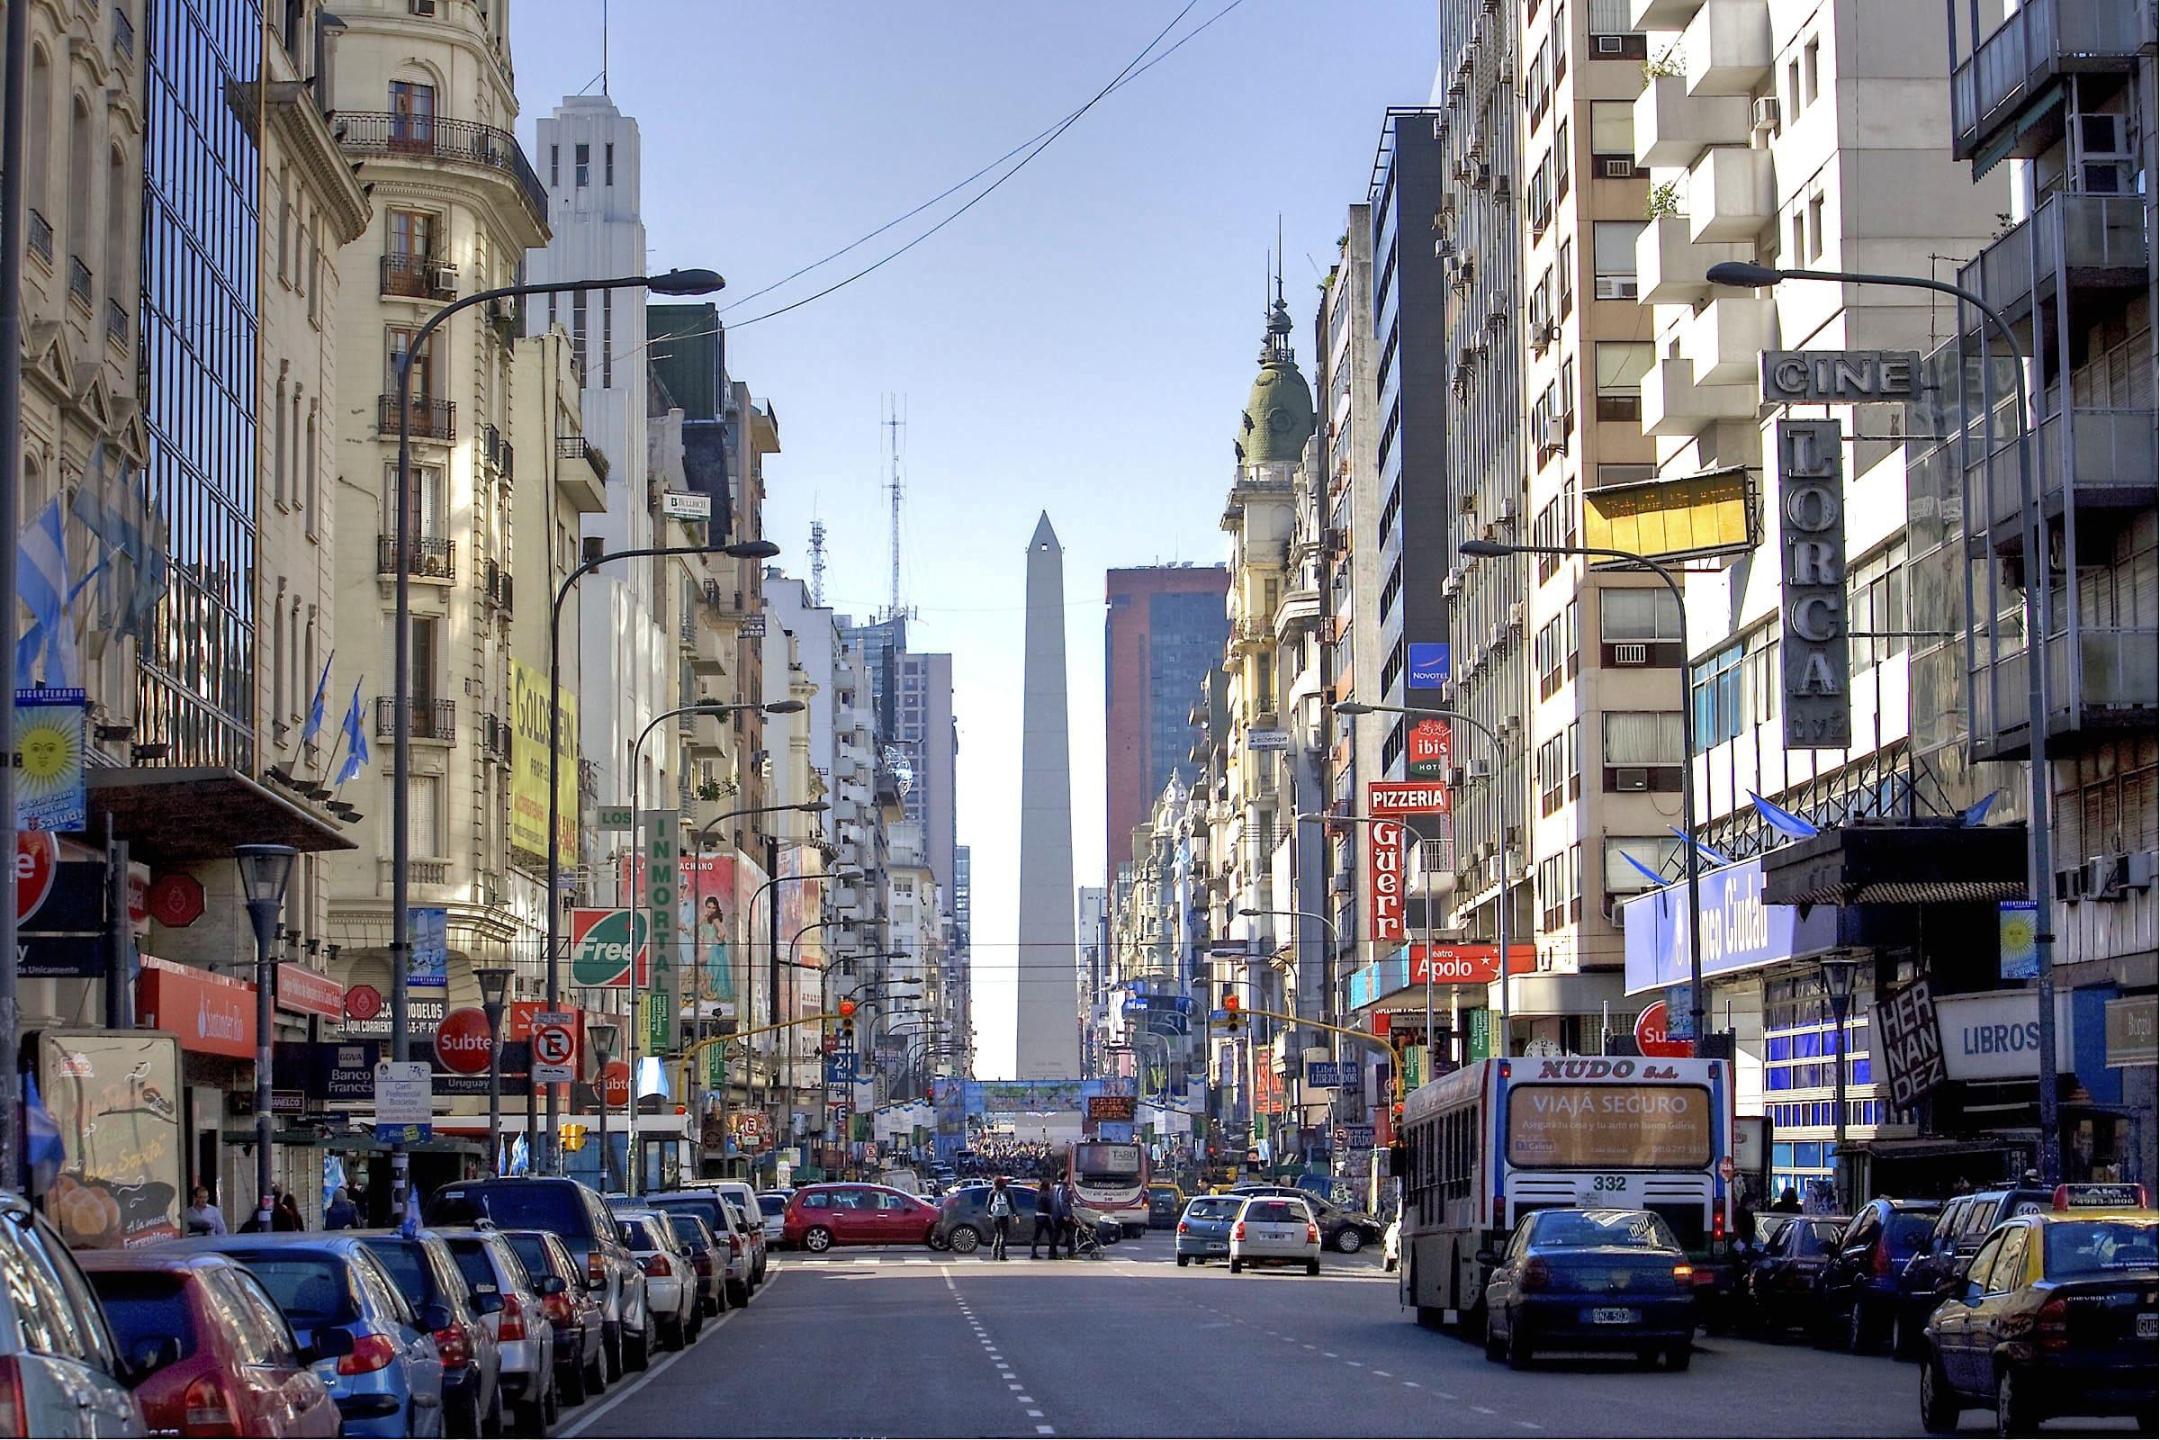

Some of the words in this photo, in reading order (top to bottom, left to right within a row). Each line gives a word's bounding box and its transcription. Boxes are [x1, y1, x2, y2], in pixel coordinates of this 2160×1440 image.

[1774, 358, 1912, 394] CINE
[1786, 429, 1842, 697] LORCA
[1413, 672, 1449, 680] NOVOTEL
[516, 667, 574, 760] GOLDSEIN
[1418, 739, 1447, 755] ibis
[1372, 789, 1444, 808] PIZZERIA
[602, 812, 632, 824] LOS
[652, 819, 672, 993] INMORTAL
[1725, 873, 1768, 954] Ciudad
[1417, 957, 1472, 981] Apolo
[1880, 983, 1933, 1046] HER
[442, 1034, 493, 1051] Subte
[1963, 1021, 2040, 1055] LIBROS
[339, 1052, 363, 1062] BBVA
[1887, 1022, 1938, 1079] NAN
[332, 1069, 371, 1081] Banco
[1538, 1060, 1635, 1079] NUDO
[1893, 1058, 1943, 1102] DEZ
[328, 1080, 374, 1093] Francés
[447, 1079, 490, 1090] Uruguay
[1533, 1091, 1595, 1118] VIAJÁ
[1602, 1095, 1688, 1113] SEGURO
[1593, 1175, 1627, 1191] 332
